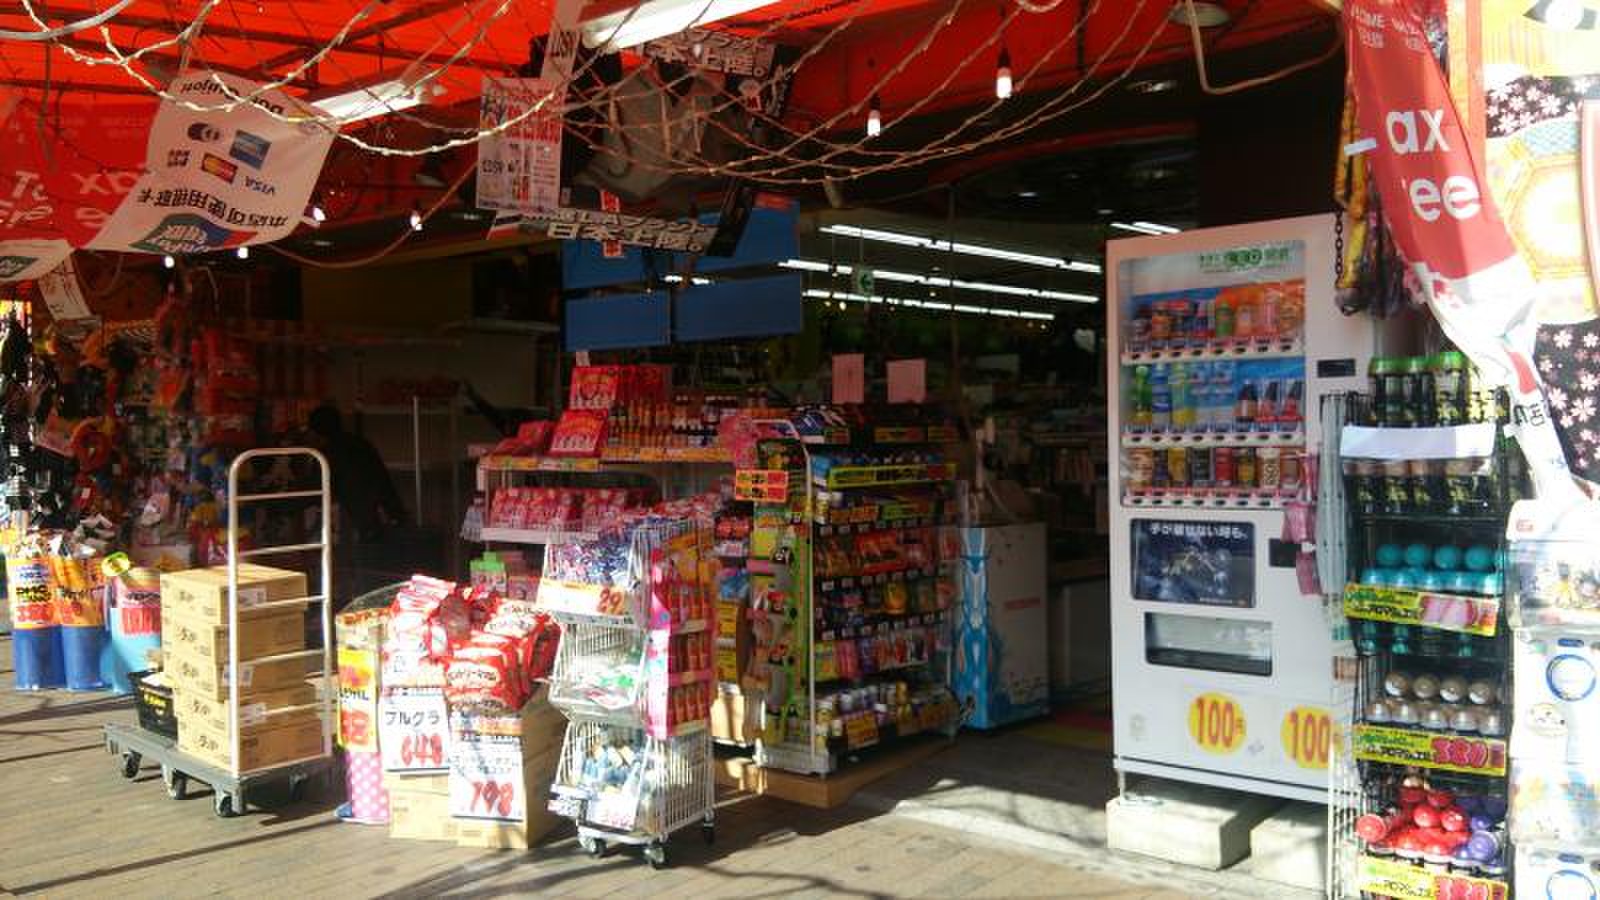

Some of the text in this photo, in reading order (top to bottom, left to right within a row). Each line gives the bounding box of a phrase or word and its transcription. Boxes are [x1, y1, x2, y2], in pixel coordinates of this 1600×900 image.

[244, 176, 276, 197] VISA
[1402, 175, 1482, 222] ee
[384, 709, 441, 727] フルグラ
[401, 732, 443, 767] 648
[470, 780, 514, 817] 798
